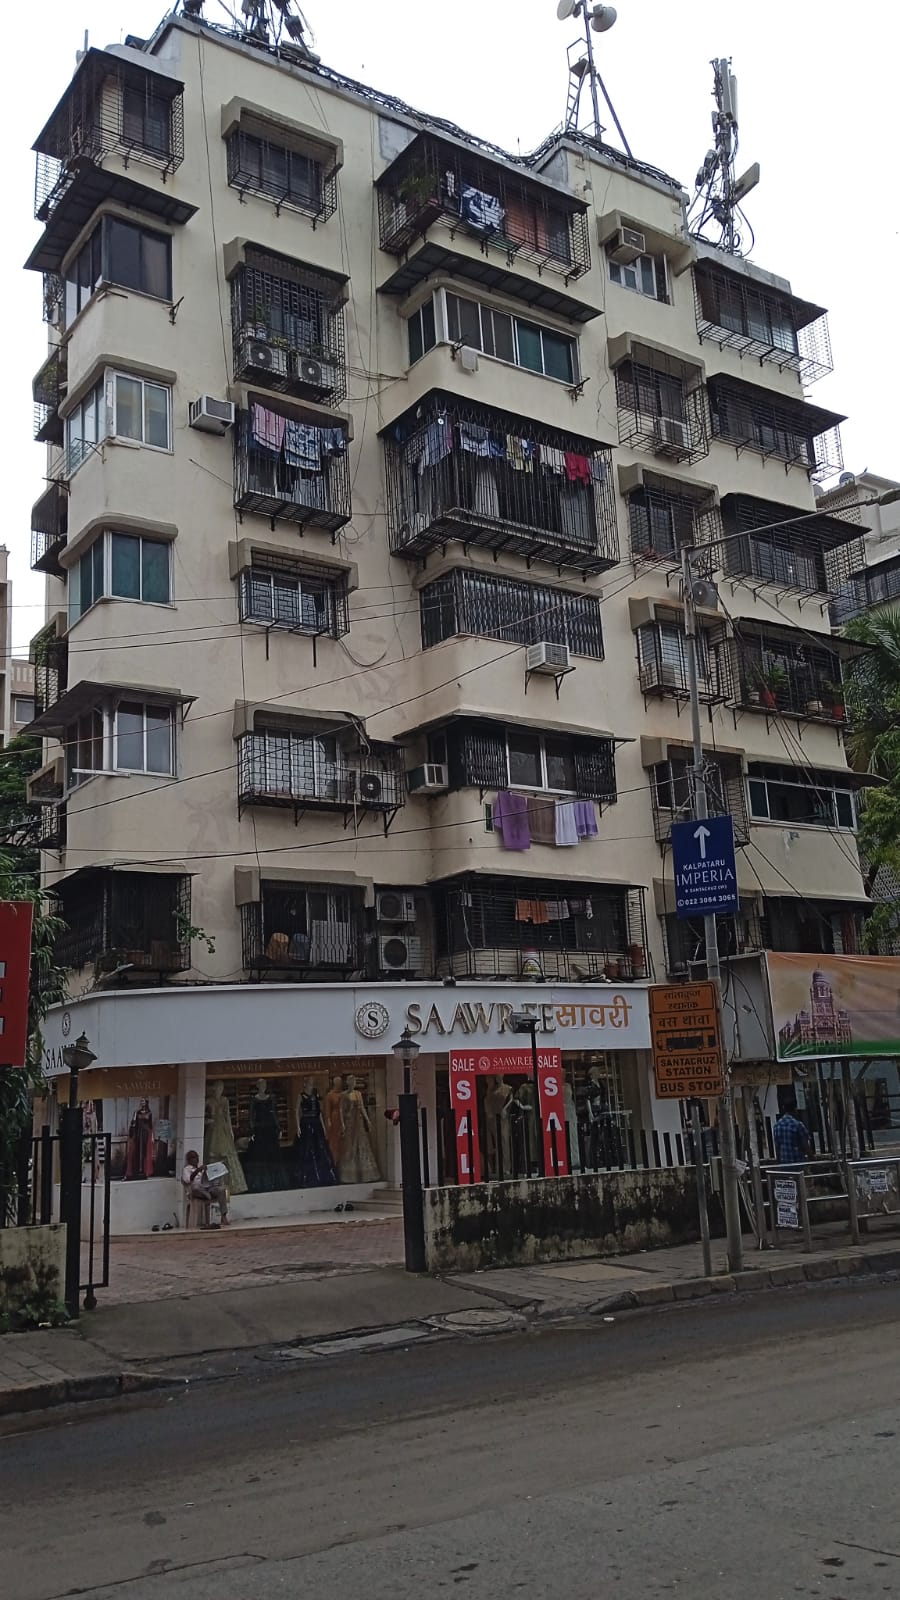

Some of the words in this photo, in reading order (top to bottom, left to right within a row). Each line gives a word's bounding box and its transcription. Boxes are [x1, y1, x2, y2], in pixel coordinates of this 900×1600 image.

[683, 859, 726, 871] KALPATARU
[676, 868, 735, 887] IMPERIA
[685, 898, 698, 906] 022
[551, 995, 632, 1028] सावरी
[452, 1058, 475, 1072] SALE
[538, 1055, 558, 1068] SALE
[660, 1056, 716, 1068] SANTACRUZ
[665, 1066, 712, 1077] STATION
[660, 1082, 685, 1093] BUS
[688, 1080, 720, 1091] STOP
